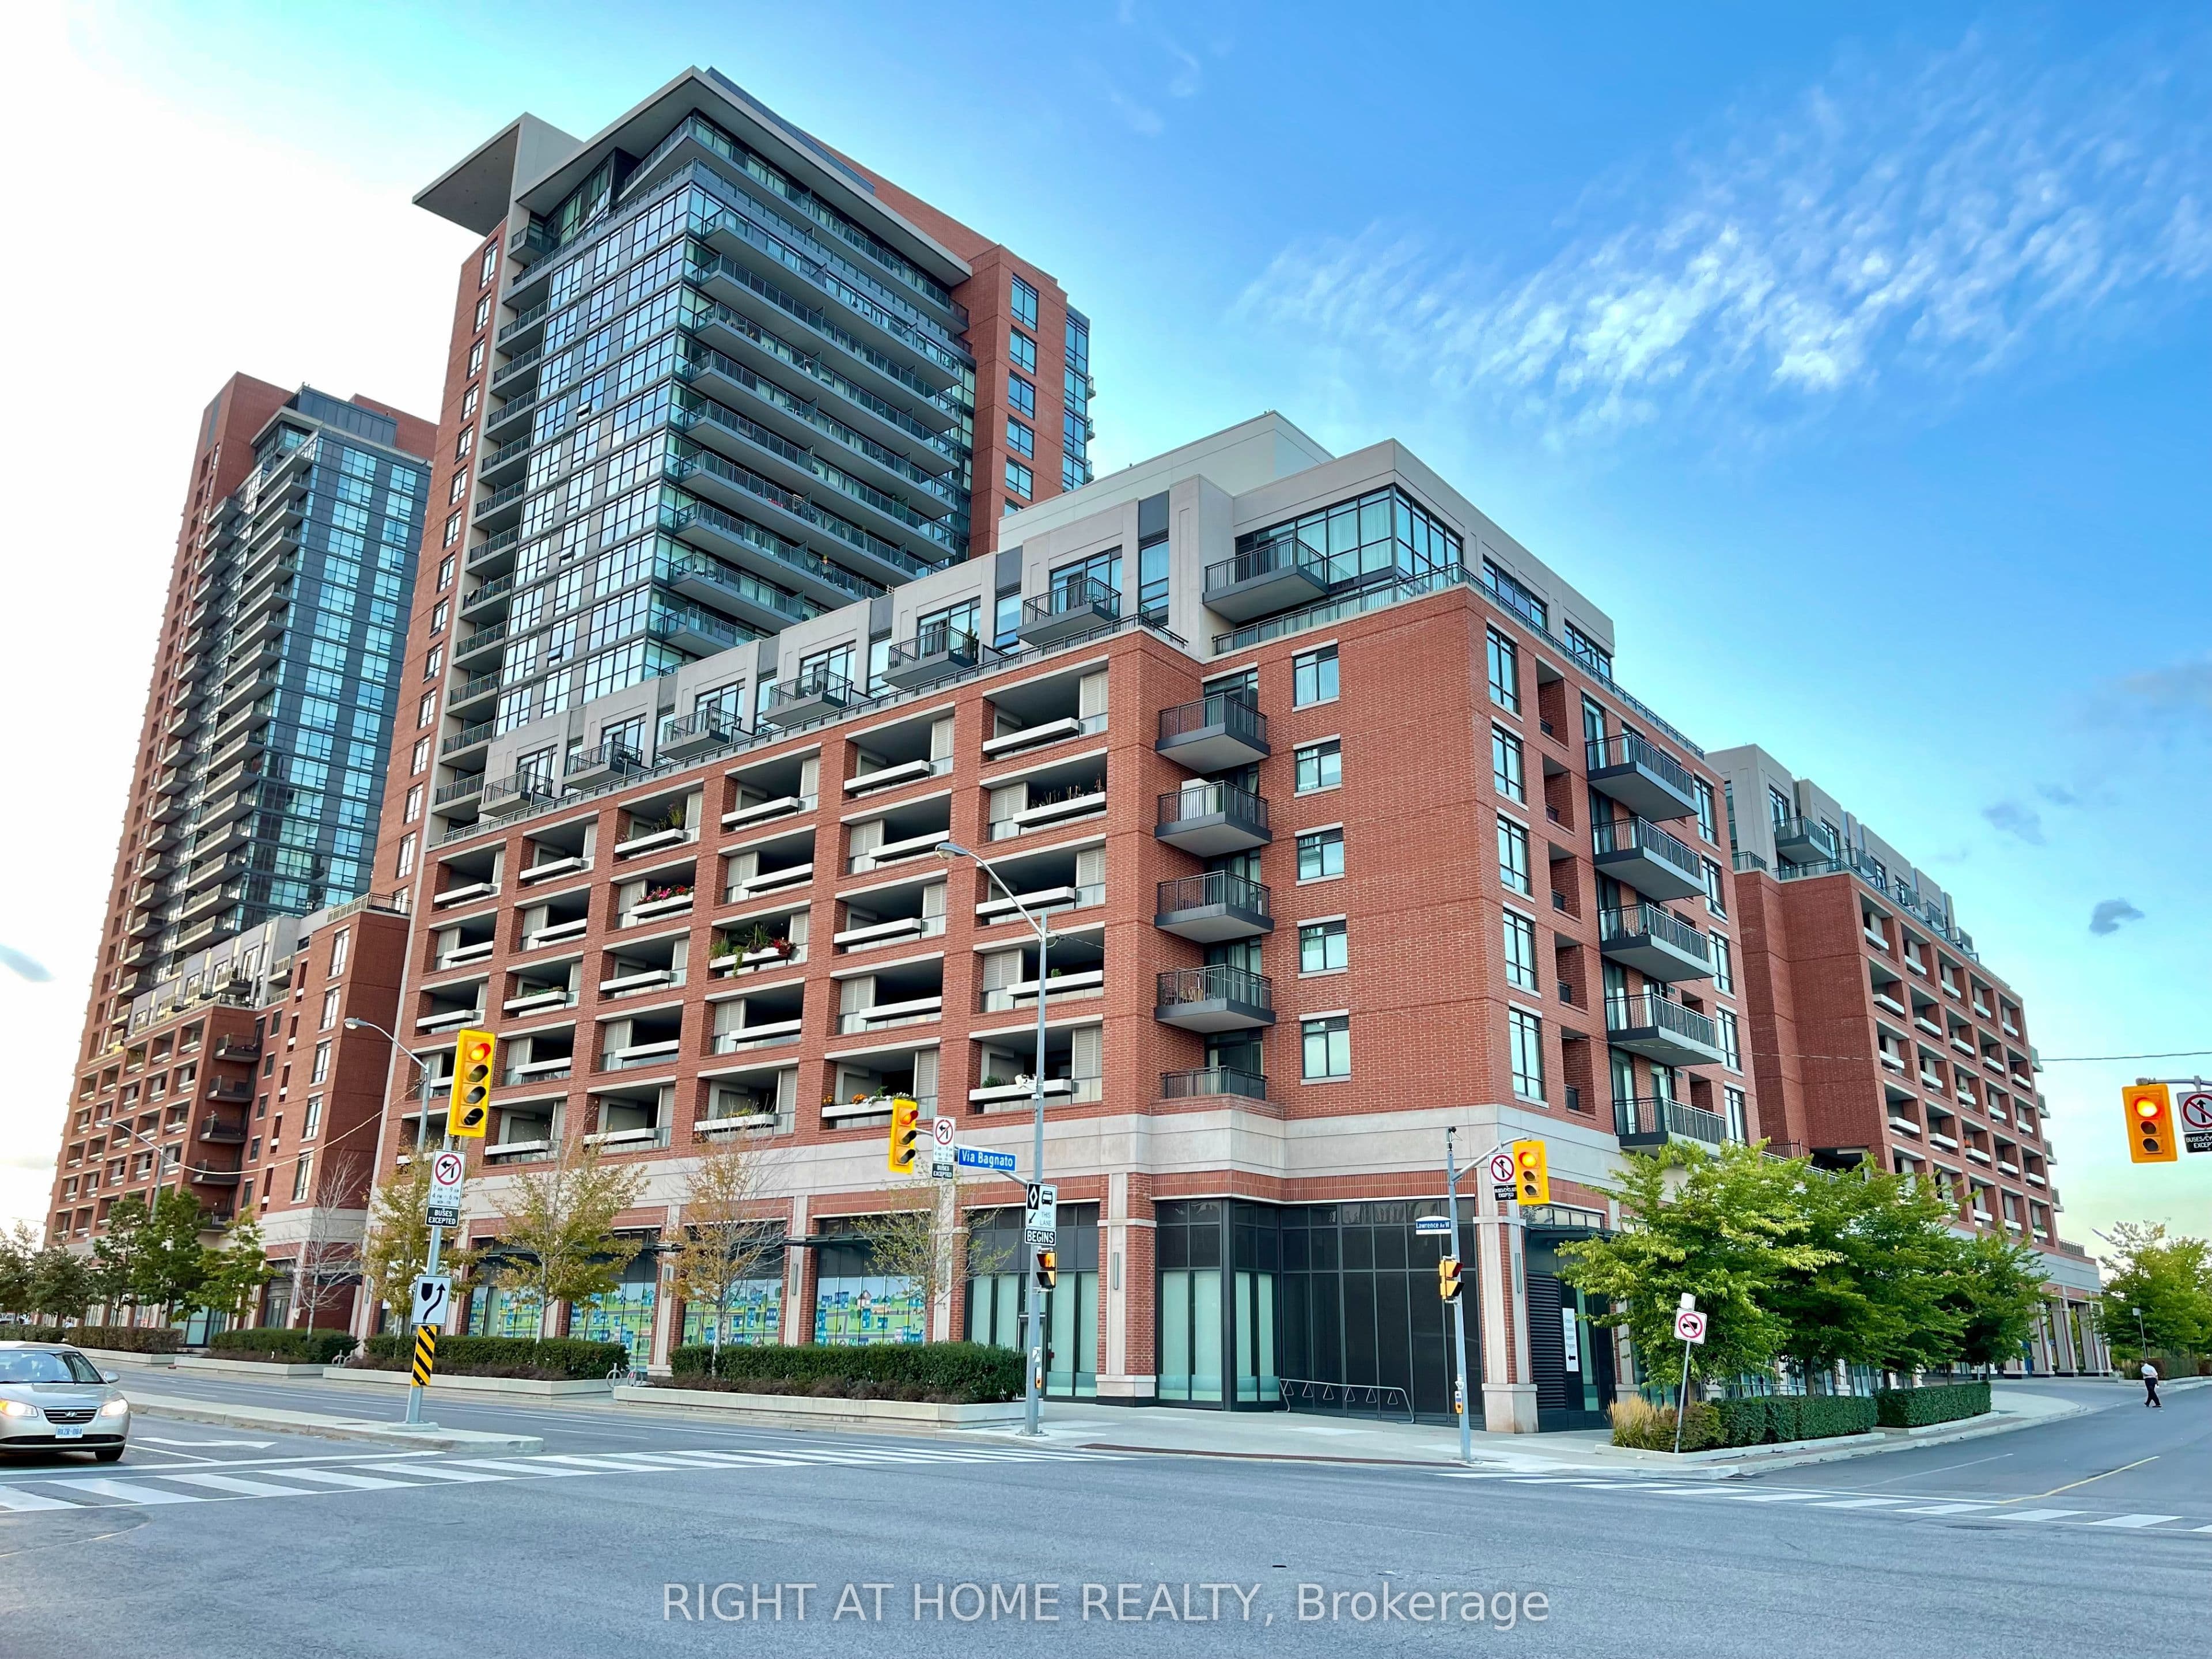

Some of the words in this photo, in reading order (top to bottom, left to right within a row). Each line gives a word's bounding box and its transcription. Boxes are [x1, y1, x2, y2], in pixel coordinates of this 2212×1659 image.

[962, 1150, 975, 1162] Via
[978, 1152, 1013, 1168] Bagnato
[429, 1217, 456, 1225] EXCEPTED
[1027, 1230, 1054, 1244] BEGINS
